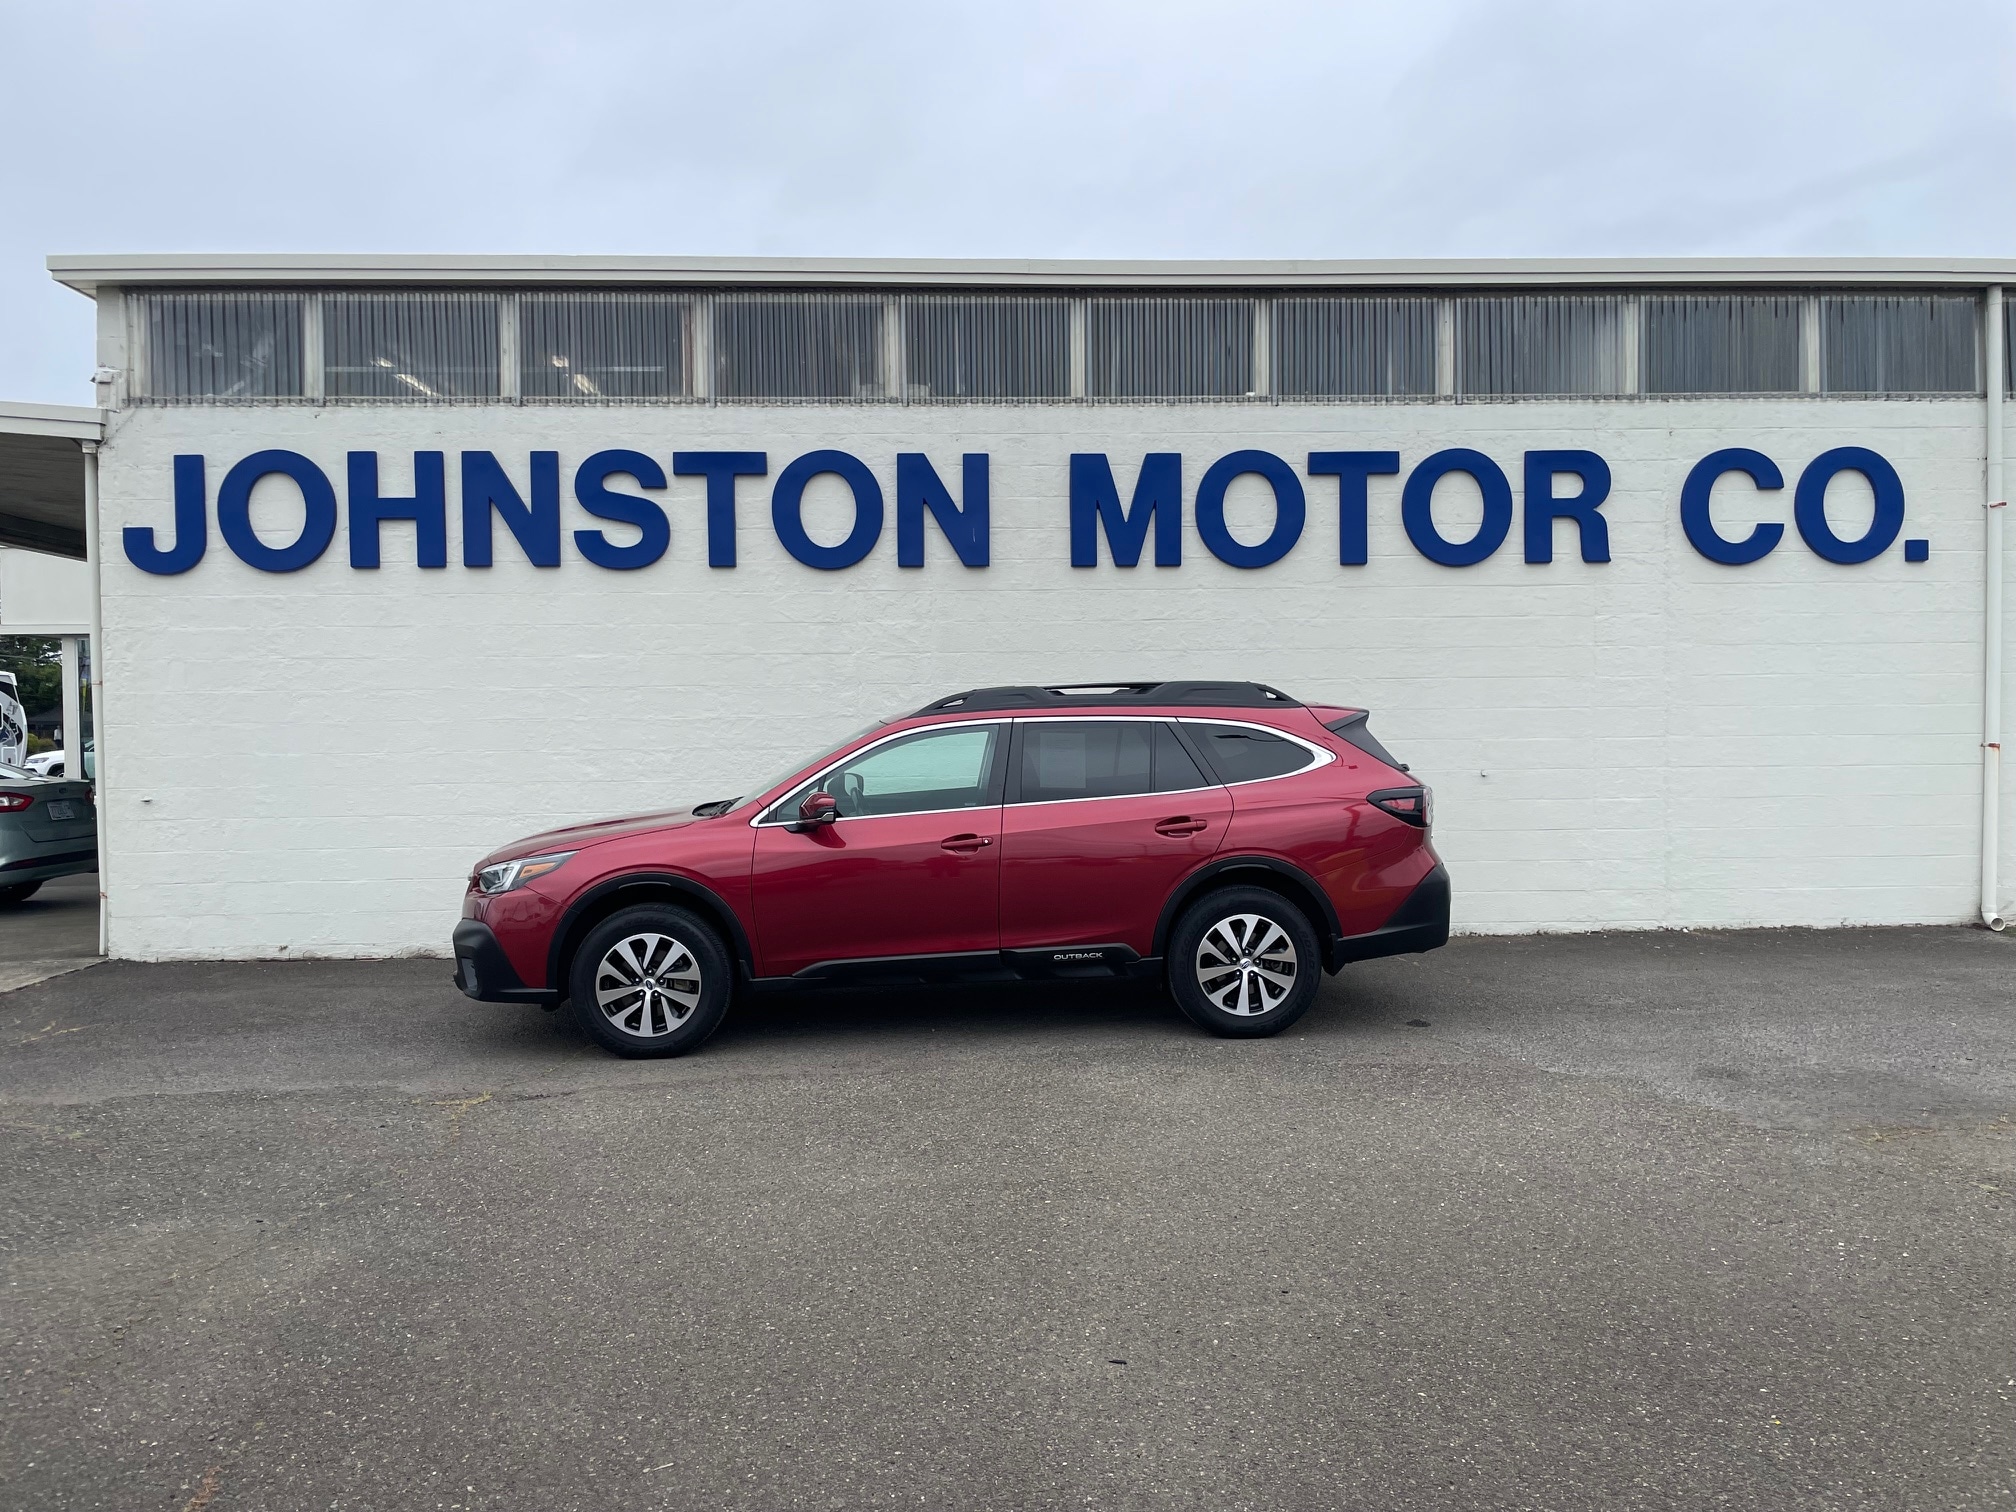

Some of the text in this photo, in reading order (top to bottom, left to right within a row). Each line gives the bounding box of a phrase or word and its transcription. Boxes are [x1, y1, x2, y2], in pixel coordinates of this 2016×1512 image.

[124, 446, 1929, 575] JOHNSTON MOTOR CO.
[1053, 952, 1103, 960] OUTBACK
